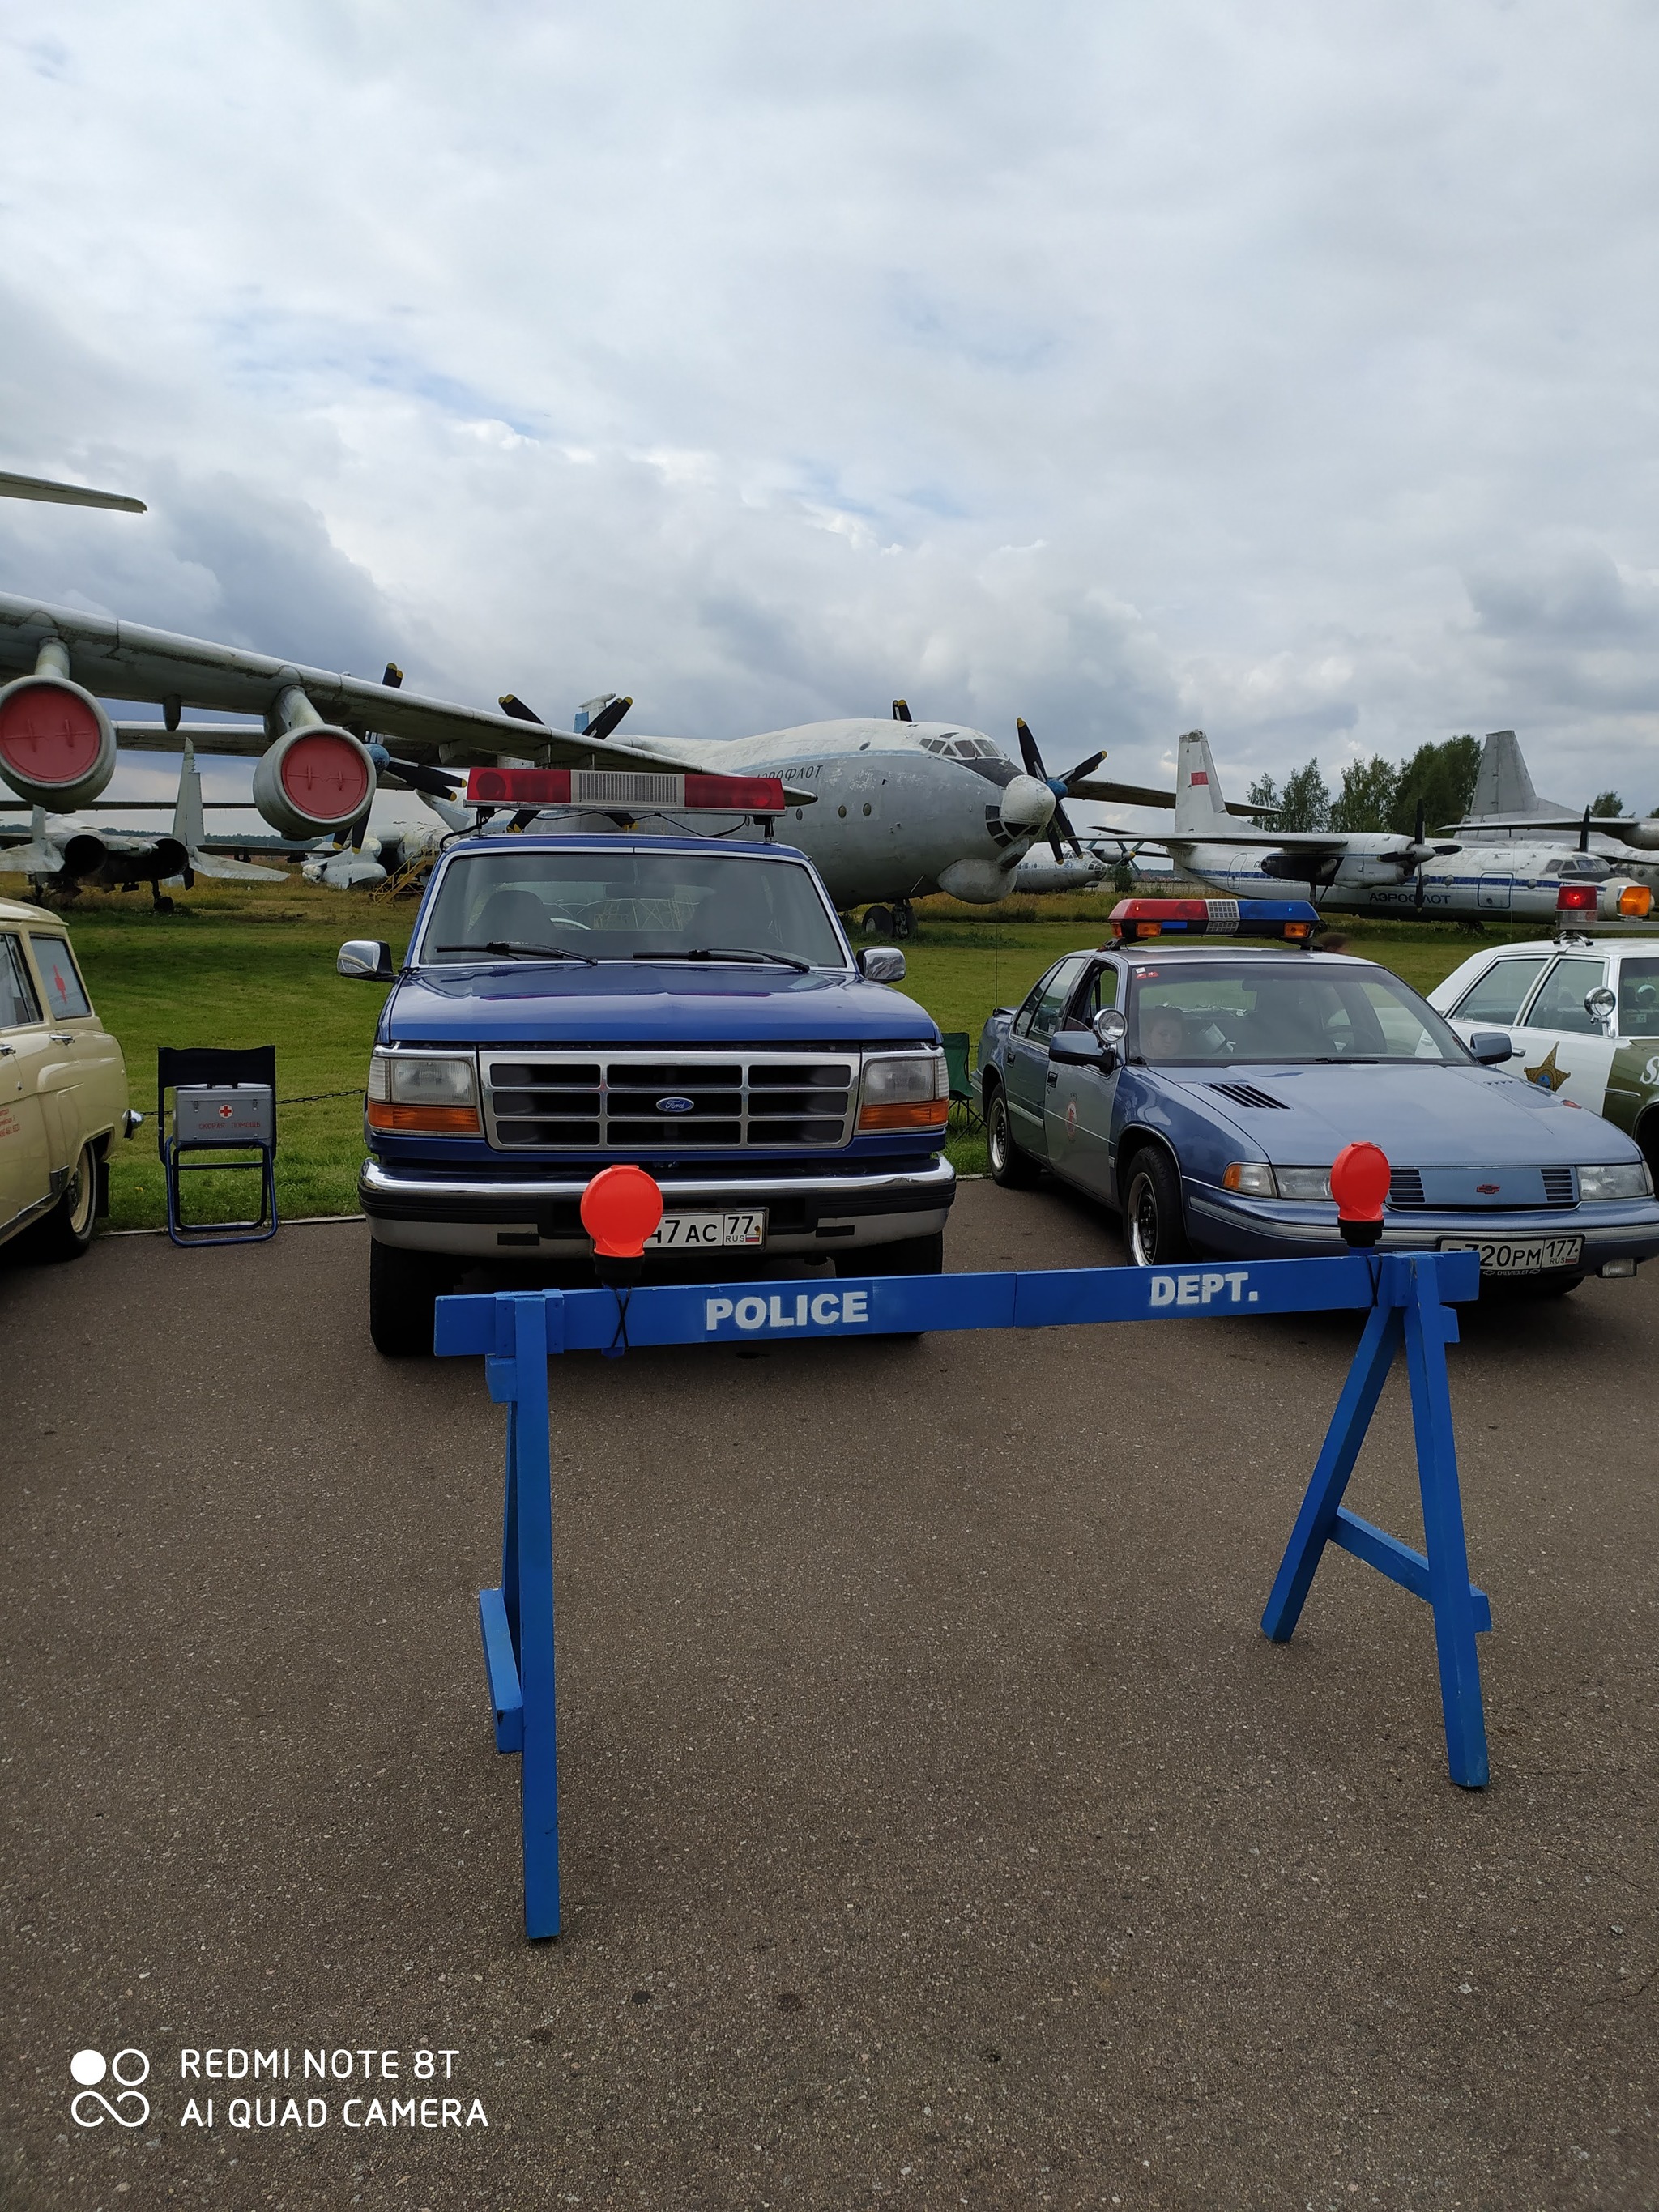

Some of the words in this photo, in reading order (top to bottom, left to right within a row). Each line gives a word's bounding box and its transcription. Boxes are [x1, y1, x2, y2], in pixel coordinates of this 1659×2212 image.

[757, 765, 824, 781] РОФЛОТ
[1639, 1055, 1659, 1086] S
[665, 1099, 686, 1110] Ford
[727, 1215, 753, 1235] 77
[725, 1234, 745, 1242] RUS
[1448, 1243, 1542, 1267] 20РМ
[1546, 1239, 1575, 1258] 177
[1550, 1256, 1565, 1264] RUS
[1496, 1268, 1529, 1276] CHEVROLET
[706, 1291, 869, 1331] POLICE
[1150, 1272, 1259, 1306] DEPT.
